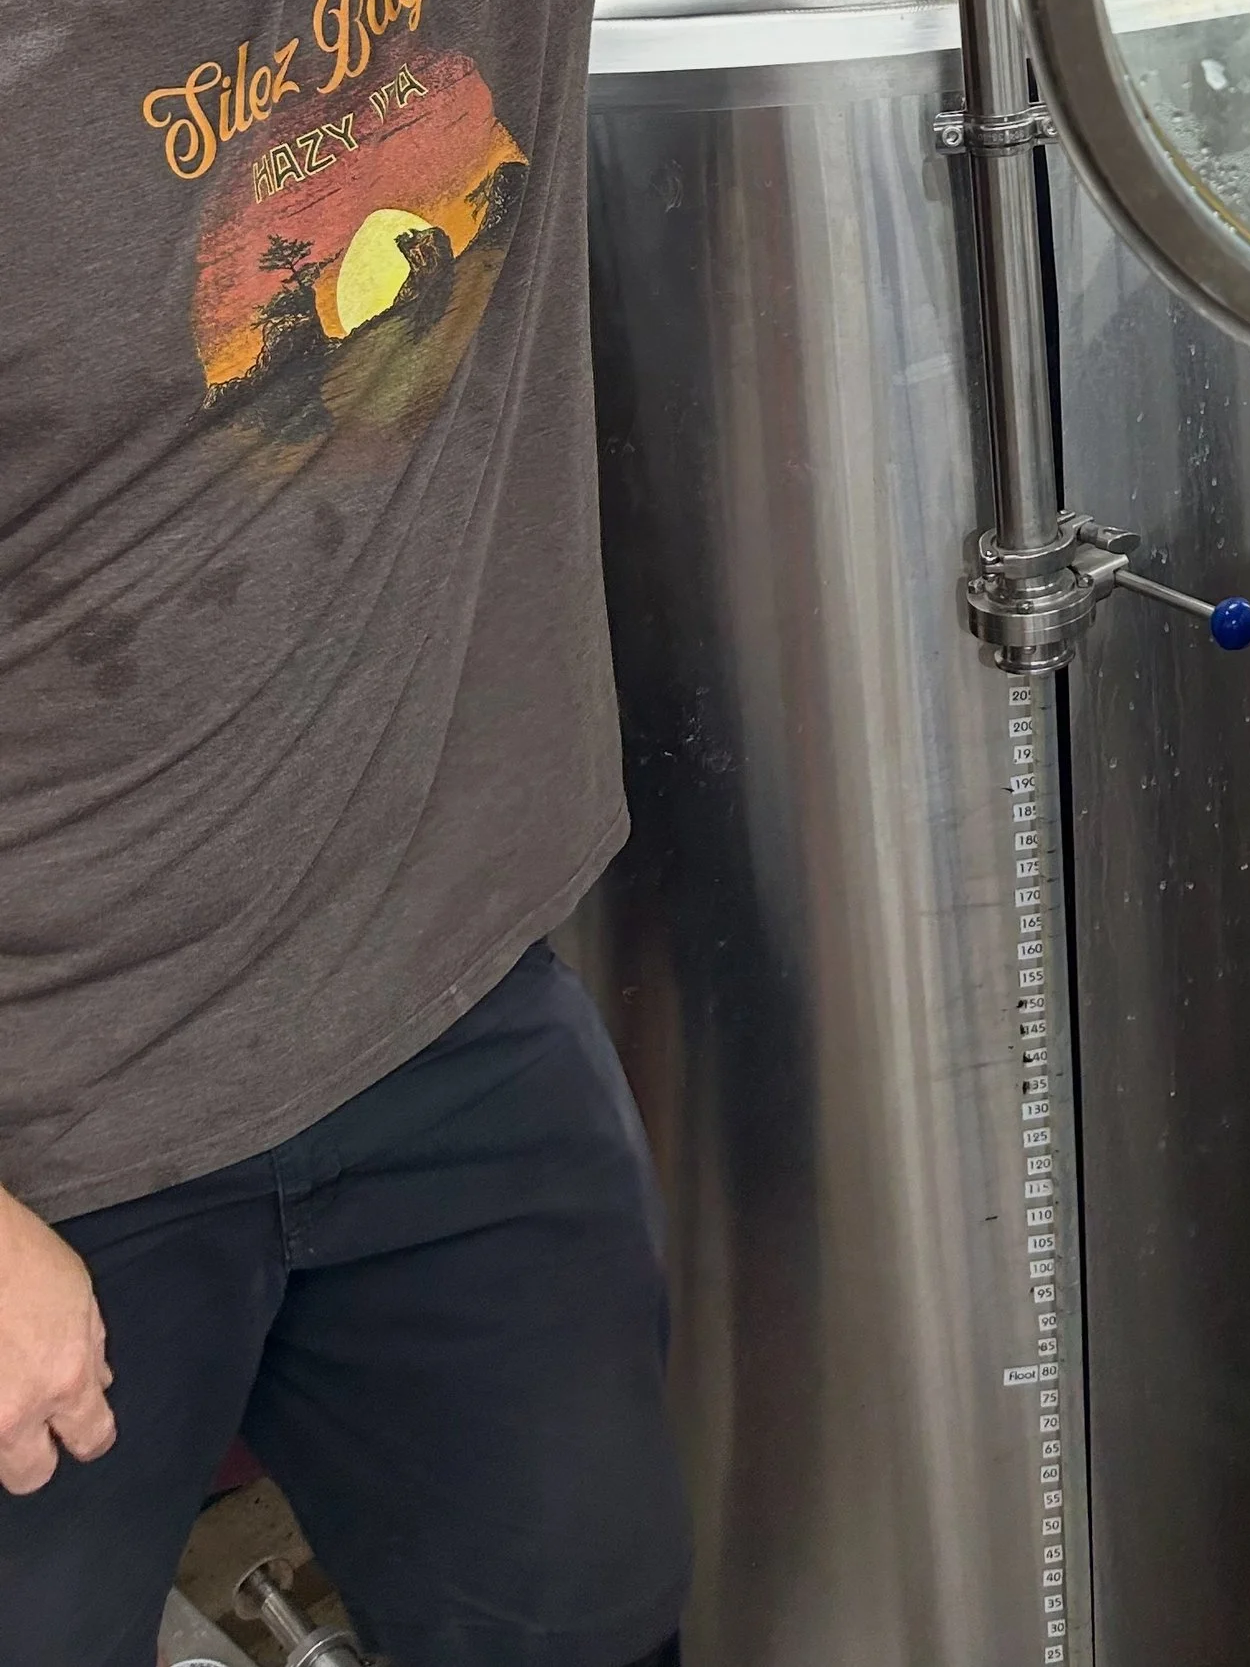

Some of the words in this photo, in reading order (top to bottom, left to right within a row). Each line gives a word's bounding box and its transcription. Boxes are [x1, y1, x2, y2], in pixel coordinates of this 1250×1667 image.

[253, 112, 359, 204] HAZY
[1012, 689, 1031, 701] 20
[1020, 861, 1040, 873] 175
[1020, 889, 1040, 902] 170
[1022, 916, 1042, 929] 165
[1021, 943, 1043, 955] 160
[1023, 970, 1044, 983] 155
[1023, 997, 1045, 1009] 150
[1025, 1022, 1046, 1035] 145
[1027, 1103, 1049, 1116] 130
[1027, 1130, 1048, 1143] 125
[1030, 1158, 1051, 1170] 120
[1029, 1183, 1049, 1194] 115
[1031, 1209, 1052, 1221] 110
[1032, 1237, 1053, 1249] 105
[1033, 1262, 1054, 1274] 100
[1037, 1287, 1052, 1299] 95
[1041, 1315, 1057, 1327] 90
[1040, 1341, 1055, 1352] 85
[1041, 1365, 1057, 1376] 80
[1042, 1392, 1057, 1404] 75
[1043, 1417, 1058, 1428] 70
[1044, 1443, 1060, 1454] 65
[1042, 1468, 1058, 1479] 60
[1046, 1493, 1060, 1505] 55
[1045, 1520, 1060, 1531] 50
[1046, 1547, 1061, 1559] 45
[1046, 1571, 1061, 1582] 40
[1047, 1597, 1062, 1609] 35
[1051, 1622, 1065, 1634] 30
[1047, 1648, 1061, 1660] 25
